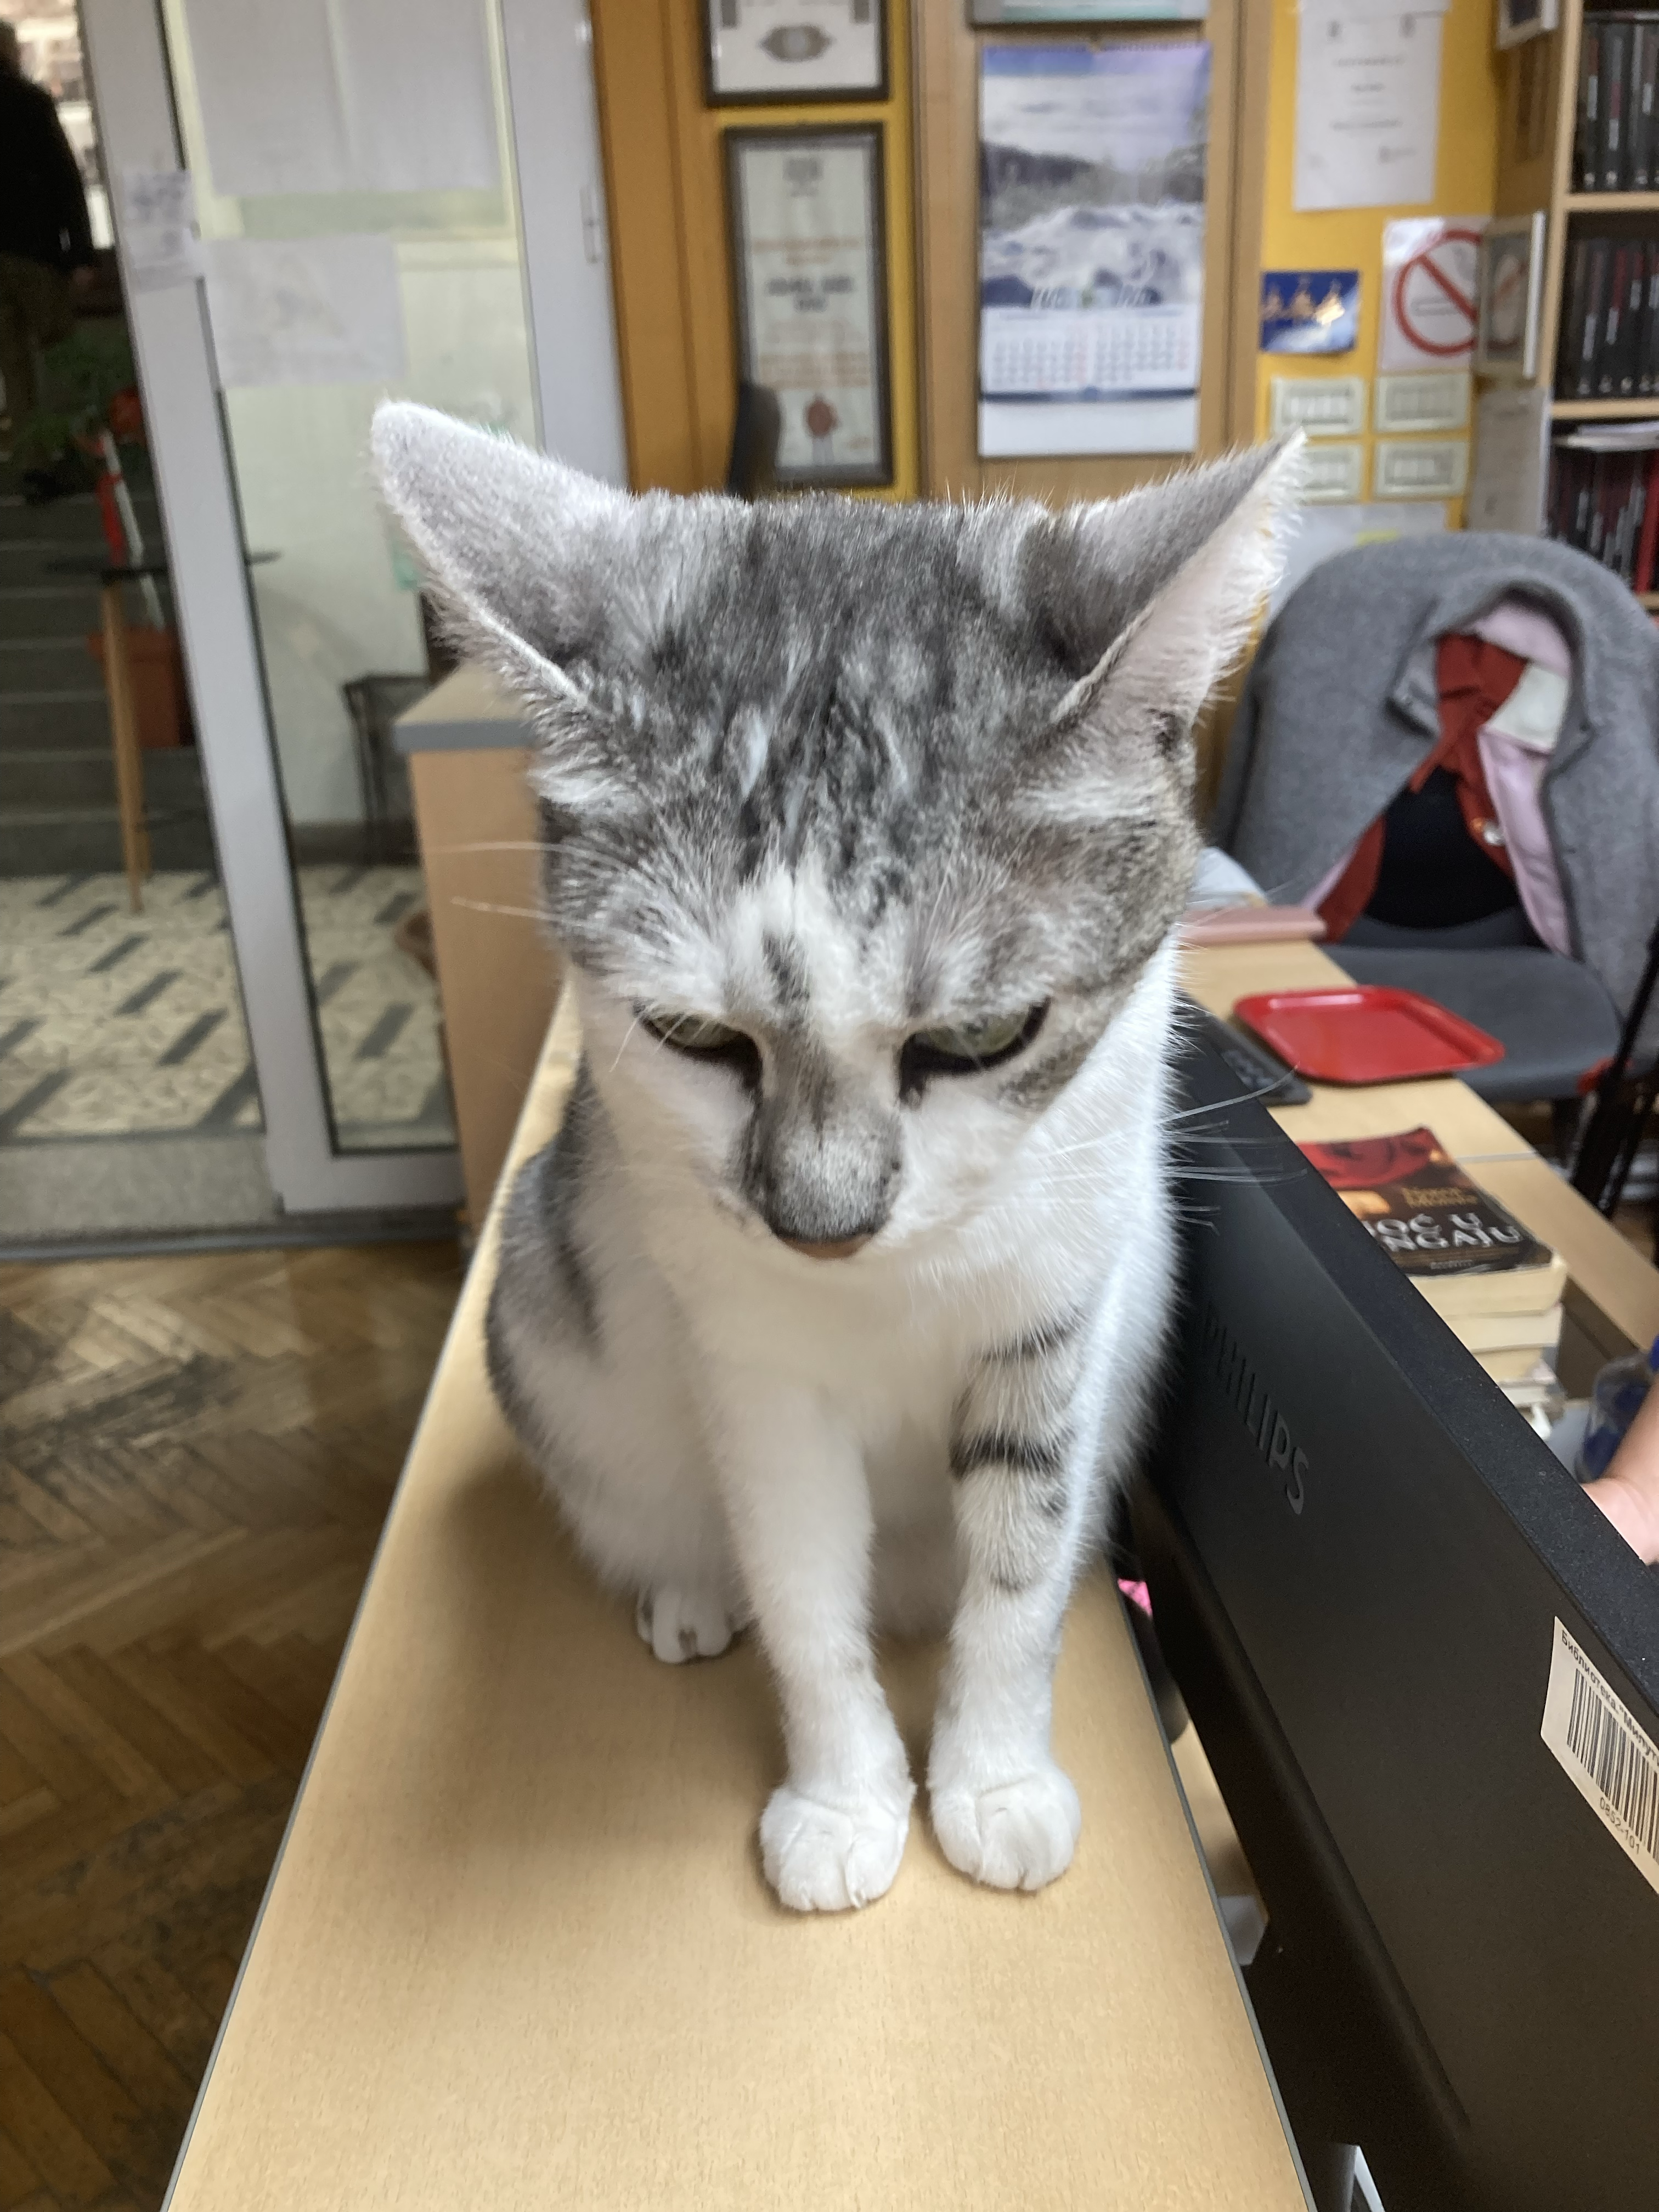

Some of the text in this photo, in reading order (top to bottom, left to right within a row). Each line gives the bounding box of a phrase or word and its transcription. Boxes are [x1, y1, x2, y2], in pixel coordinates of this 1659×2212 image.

[1448, 1212, 1483, 1230] U
[1382, 1226, 1520, 1252] NGAJU
[1203, 1301, 1309, 1515] PHILIPS
